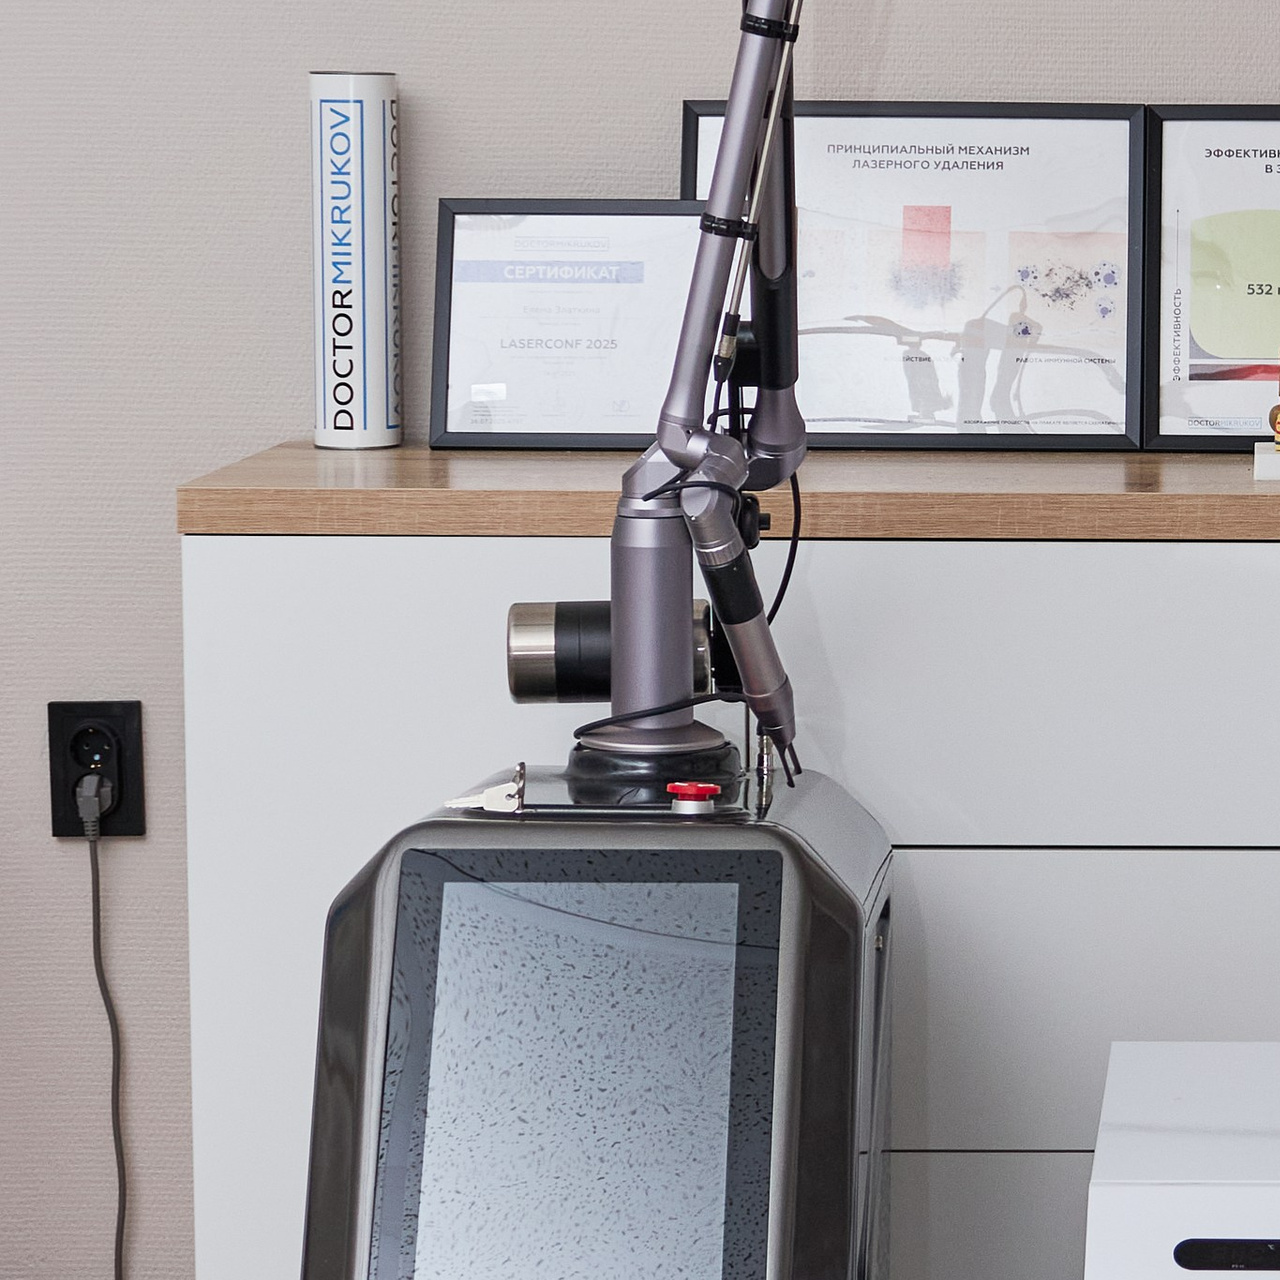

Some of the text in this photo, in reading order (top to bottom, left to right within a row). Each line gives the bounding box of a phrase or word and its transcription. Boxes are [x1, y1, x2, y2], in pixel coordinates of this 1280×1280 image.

[827, 143, 1030, 155] ПРИНЦИПИАЛЬНЫЙ МЕХАНИЗМ
[852, 160, 1004, 170] ЛАЗЕРНОГО УДАЛЕНИЯ
[1265, 165, 1273, 174] В
[329, 107, 354, 431] DOCTORMIKRUKOV
[504, 265, 620, 279] СЕРТИФИКАТ
[1247, 284, 1274, 295] 532
[1172, 288, 1182, 381] ЭФФЕКТИВНОСТЬ
[500, 338, 618, 349] LASERCONF 2025
